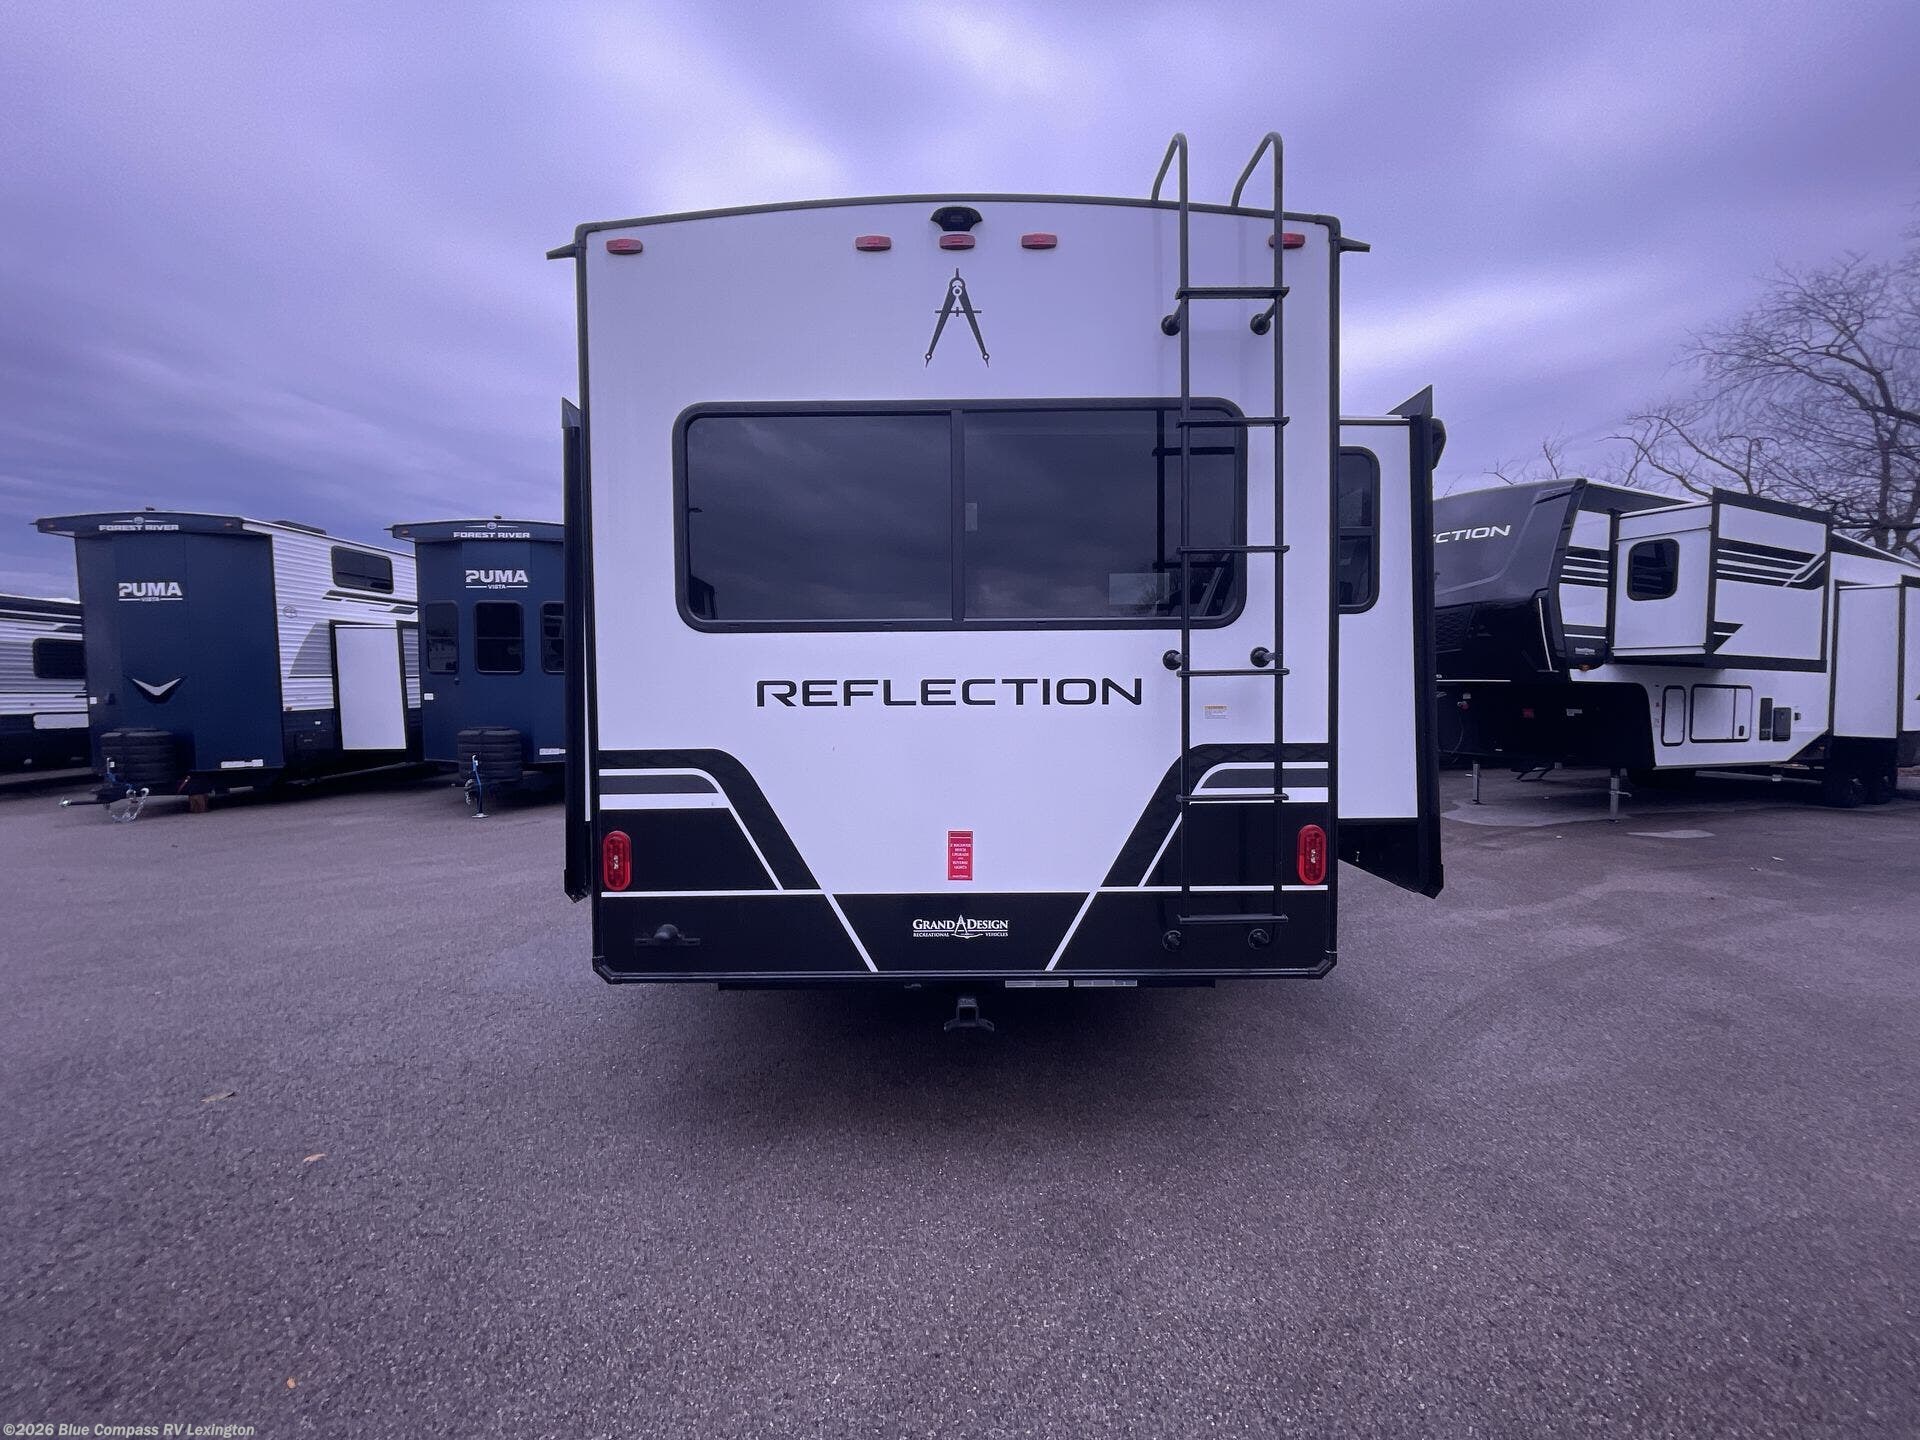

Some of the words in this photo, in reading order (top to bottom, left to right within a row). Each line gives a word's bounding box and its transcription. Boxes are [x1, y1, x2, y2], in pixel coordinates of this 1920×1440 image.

[1432, 524, 1512, 544] CTION
[465, 569, 528, 583] PUMA
[118, 582, 183, 597] PUMA
[756, 677, 1143, 707] REFLECTION
[912, 918, 956, 930] GRAND
[966, 918, 1009, 930] DESIGN
